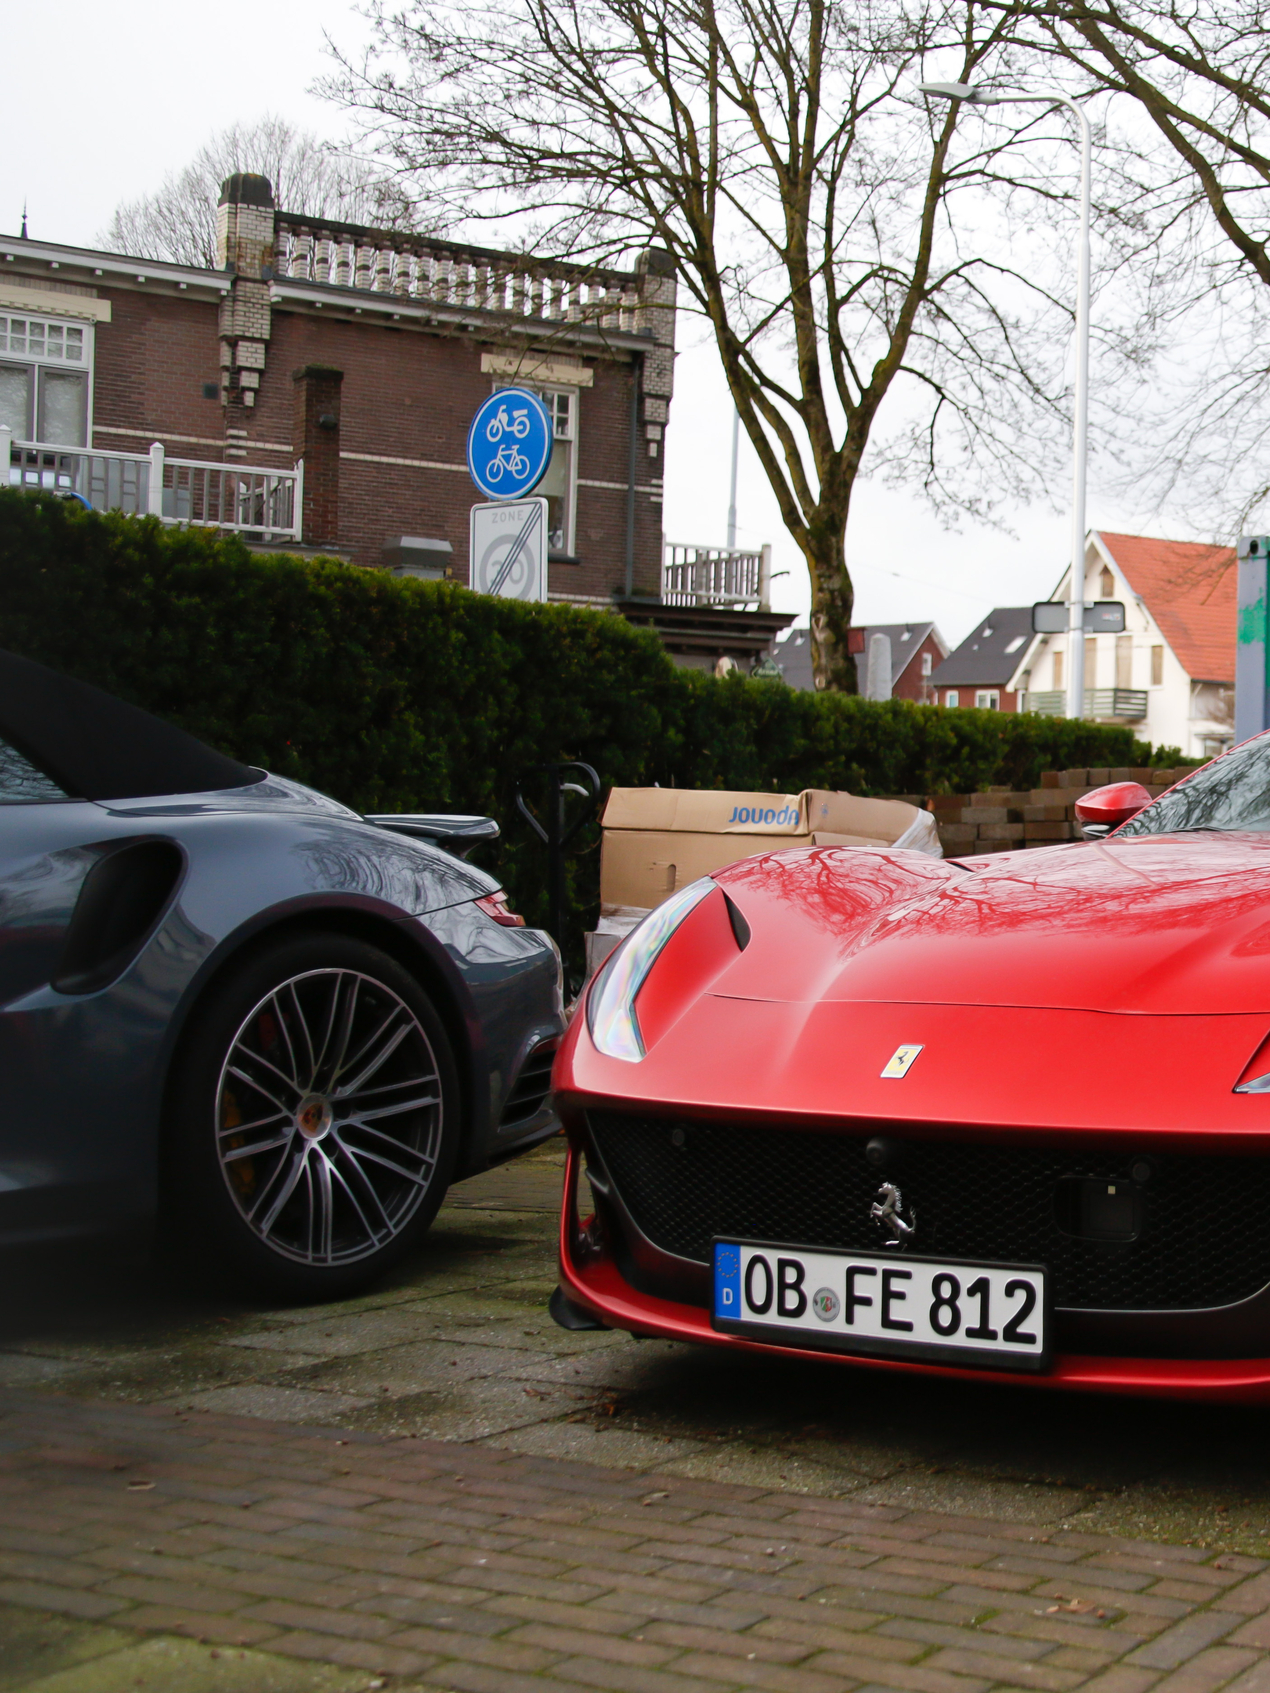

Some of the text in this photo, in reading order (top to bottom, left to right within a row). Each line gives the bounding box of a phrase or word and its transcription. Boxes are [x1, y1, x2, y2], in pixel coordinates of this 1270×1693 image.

[492, 510, 524, 524] ZONE
[728, 805, 799, 825] uponor
[722, 1287, 734, 1305] D
[744, 1253, 807, 1318] OB
[846, 1264, 914, 1332] FE
[929, 1272, 1037, 1345] 812
